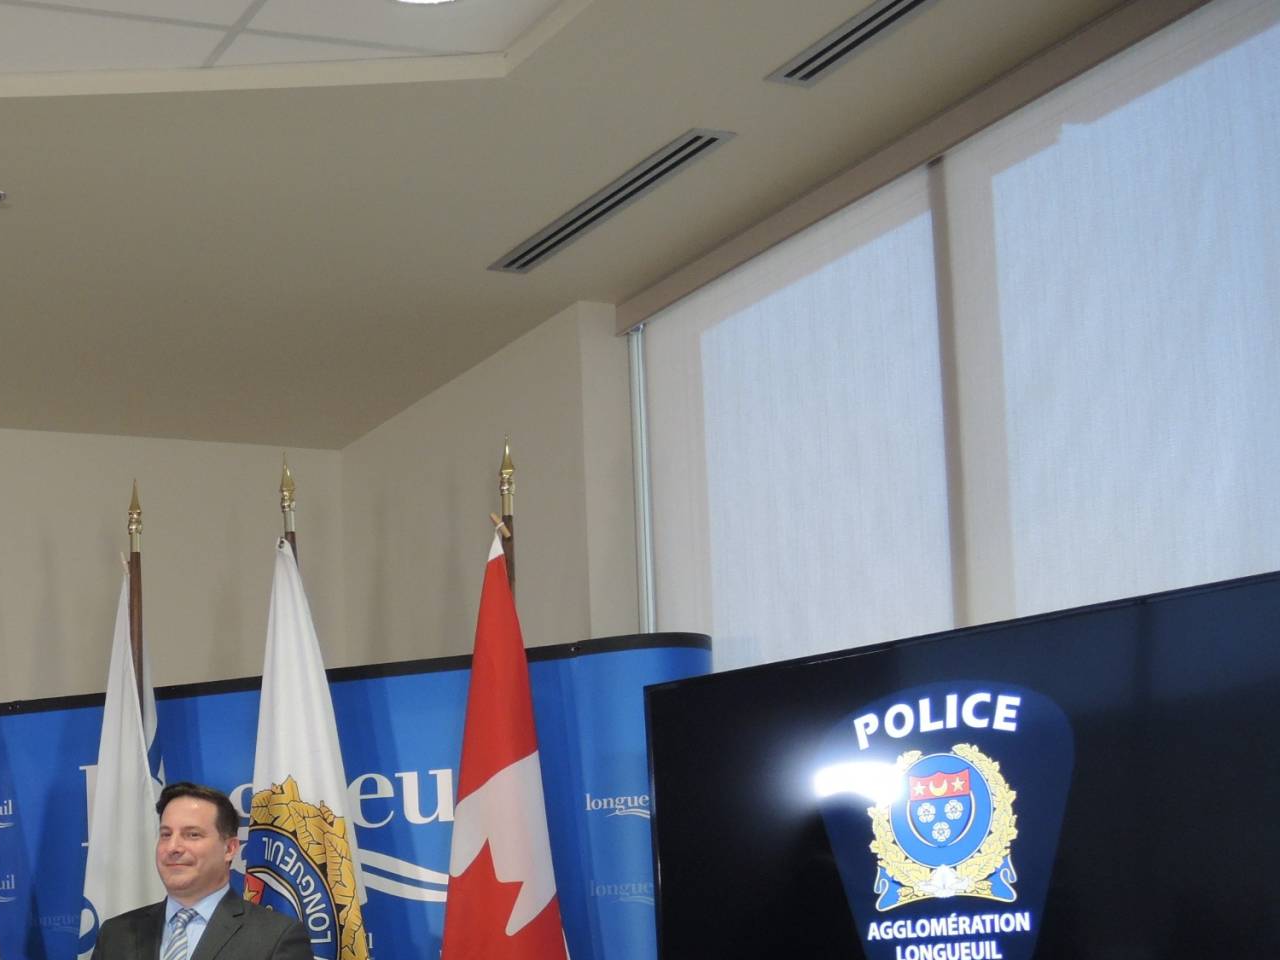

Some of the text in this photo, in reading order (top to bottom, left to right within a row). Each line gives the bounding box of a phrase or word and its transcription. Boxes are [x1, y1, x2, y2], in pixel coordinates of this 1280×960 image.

[853, 692, 1021, 750] POLICE
[585, 793, 650, 814] longue
[262, 836, 332, 945] LONGUEUIL
[867, 911, 1031, 941] AGGLOMÉRATION
